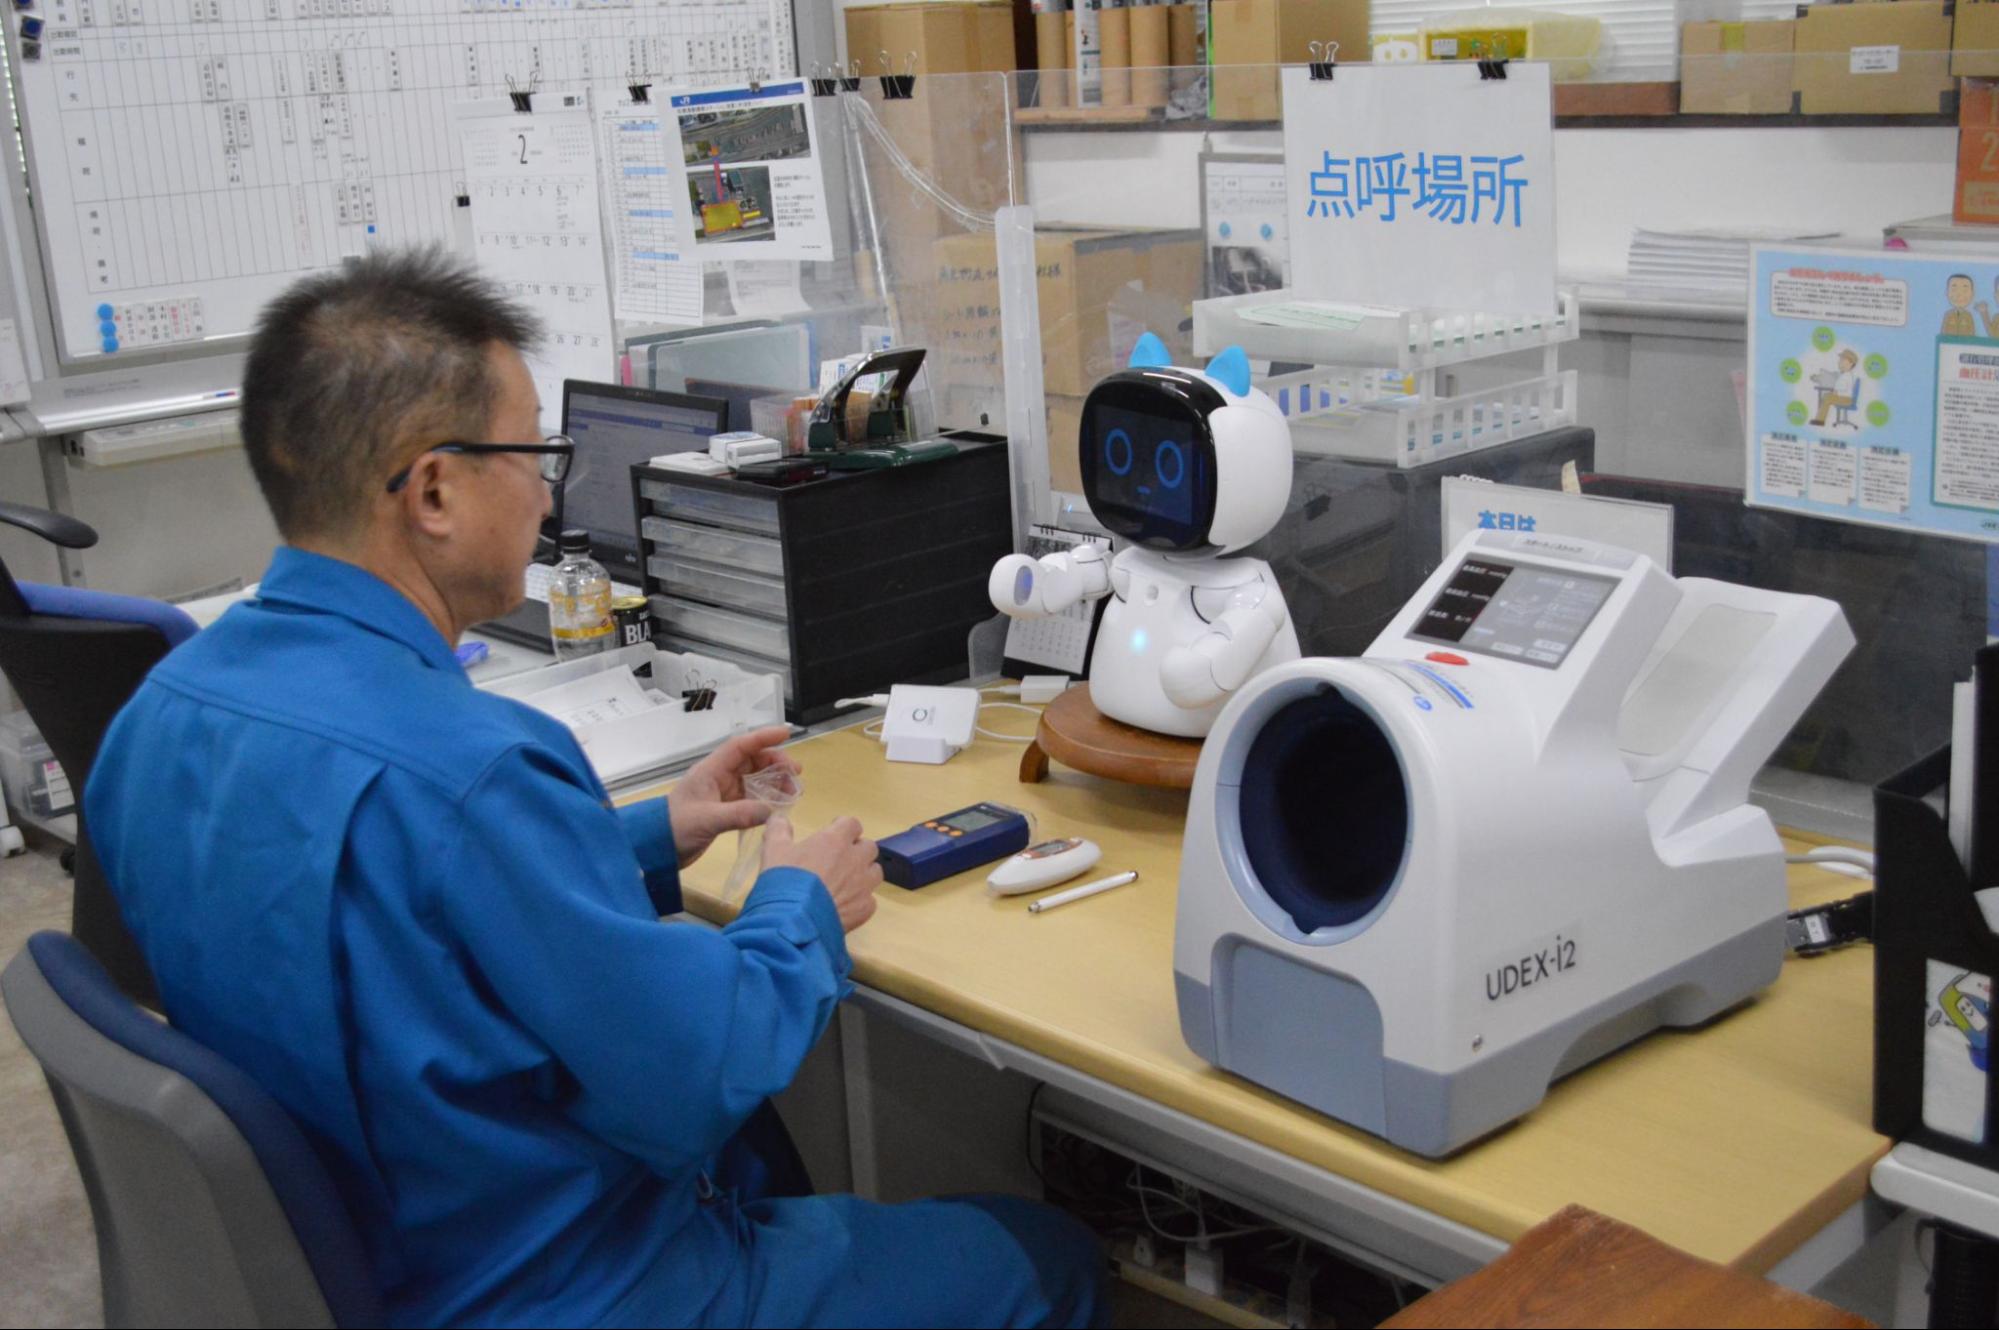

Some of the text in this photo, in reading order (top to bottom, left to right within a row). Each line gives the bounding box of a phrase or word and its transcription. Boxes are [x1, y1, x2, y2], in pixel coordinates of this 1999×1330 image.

[1306, 150, 1528, 228] 点呼場所
[1478, 509, 1537, 532] 本日は
[1485, 934, 1577, 1001] UDEX-i2
